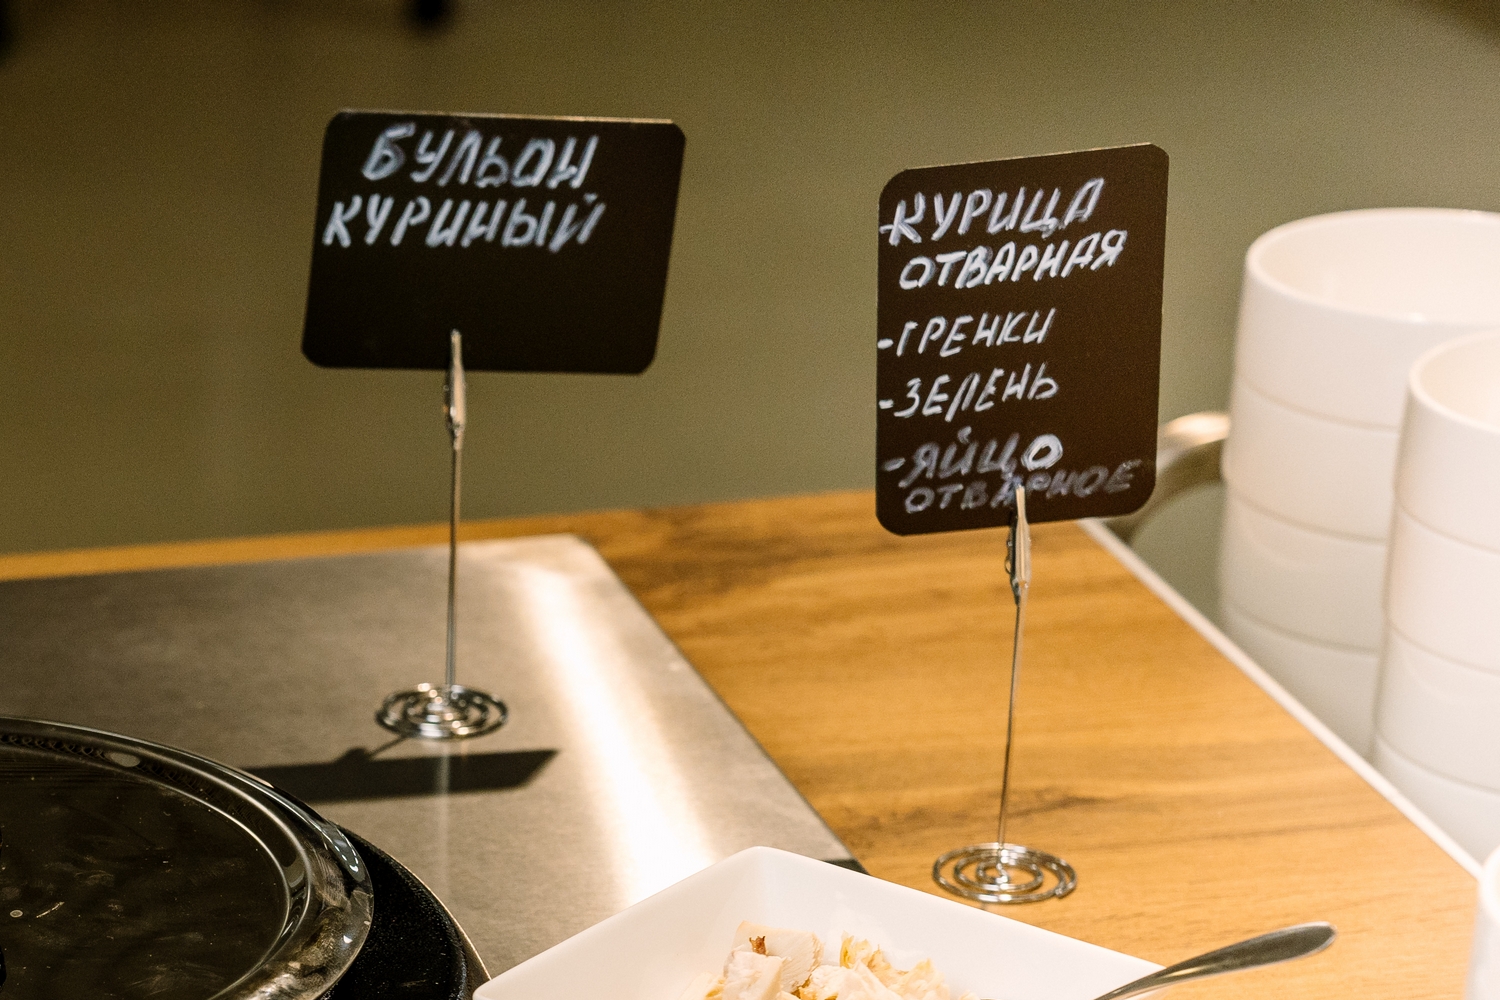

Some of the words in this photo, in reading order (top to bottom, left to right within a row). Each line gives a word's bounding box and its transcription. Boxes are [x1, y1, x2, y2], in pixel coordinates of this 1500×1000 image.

[362, 122, 599, 189] БУЛЬОН
[322, 192, 605, 253] КУРИНЫЙ
[899, 229, 1128, 290] ОТВАРНАЯ
